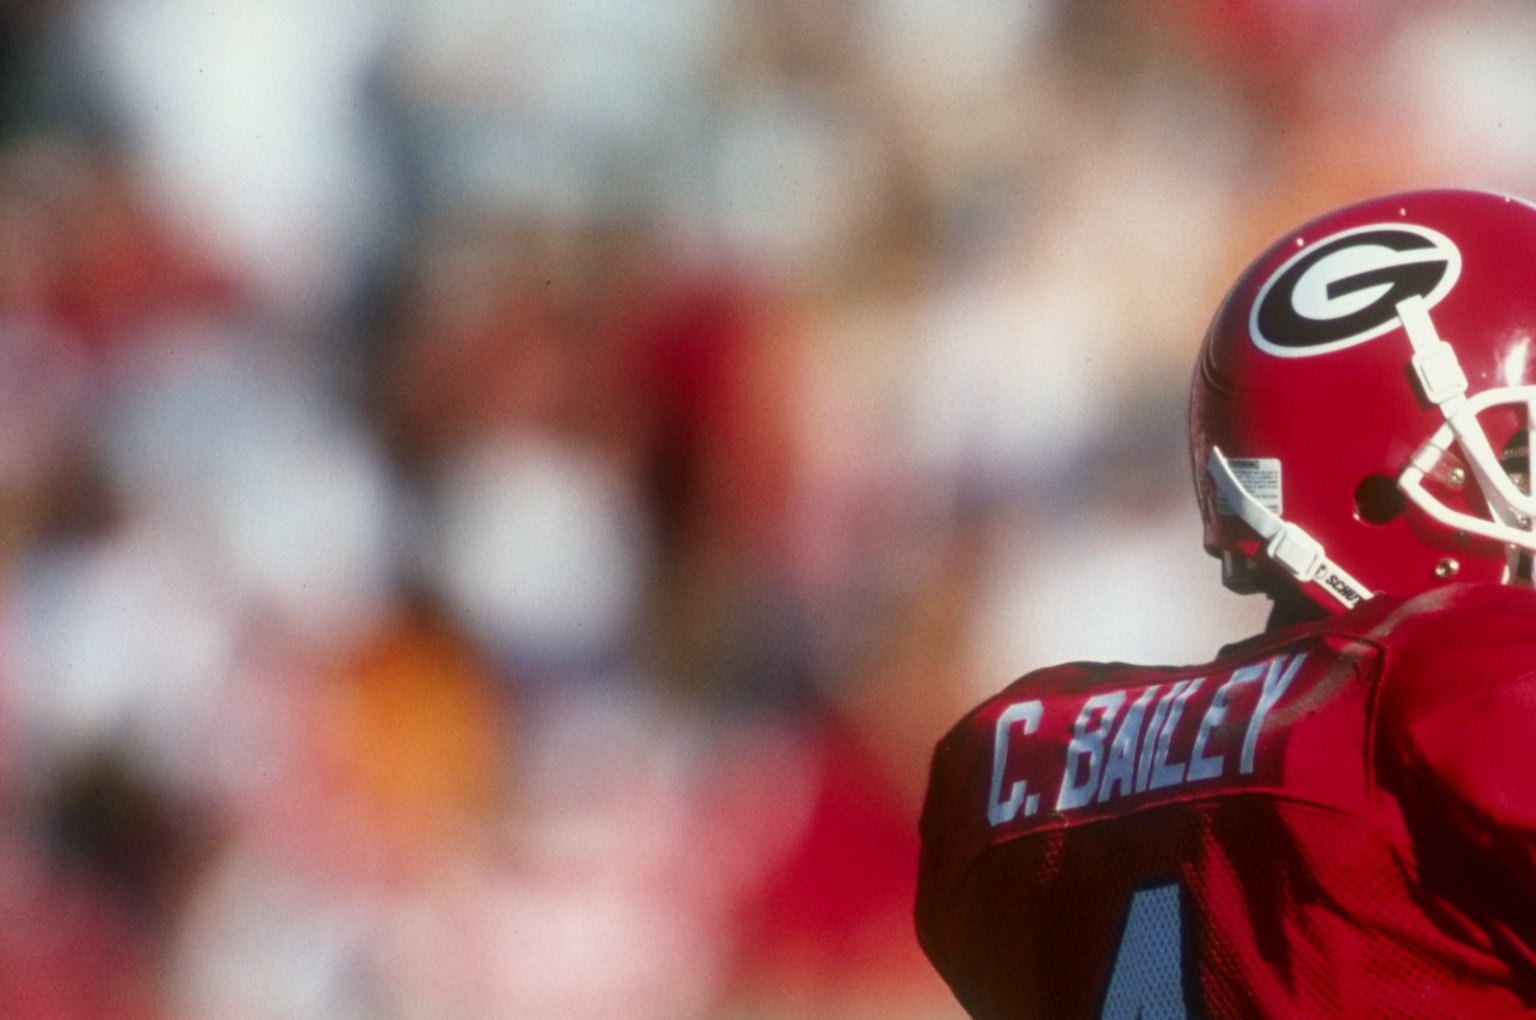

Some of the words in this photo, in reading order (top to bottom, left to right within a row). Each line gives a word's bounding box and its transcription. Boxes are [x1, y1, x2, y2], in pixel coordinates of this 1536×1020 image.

[1291, 243, 1449, 321] G
[986, 699, 1044, 827] C.
[1056, 653, 1308, 812] BAILEY
